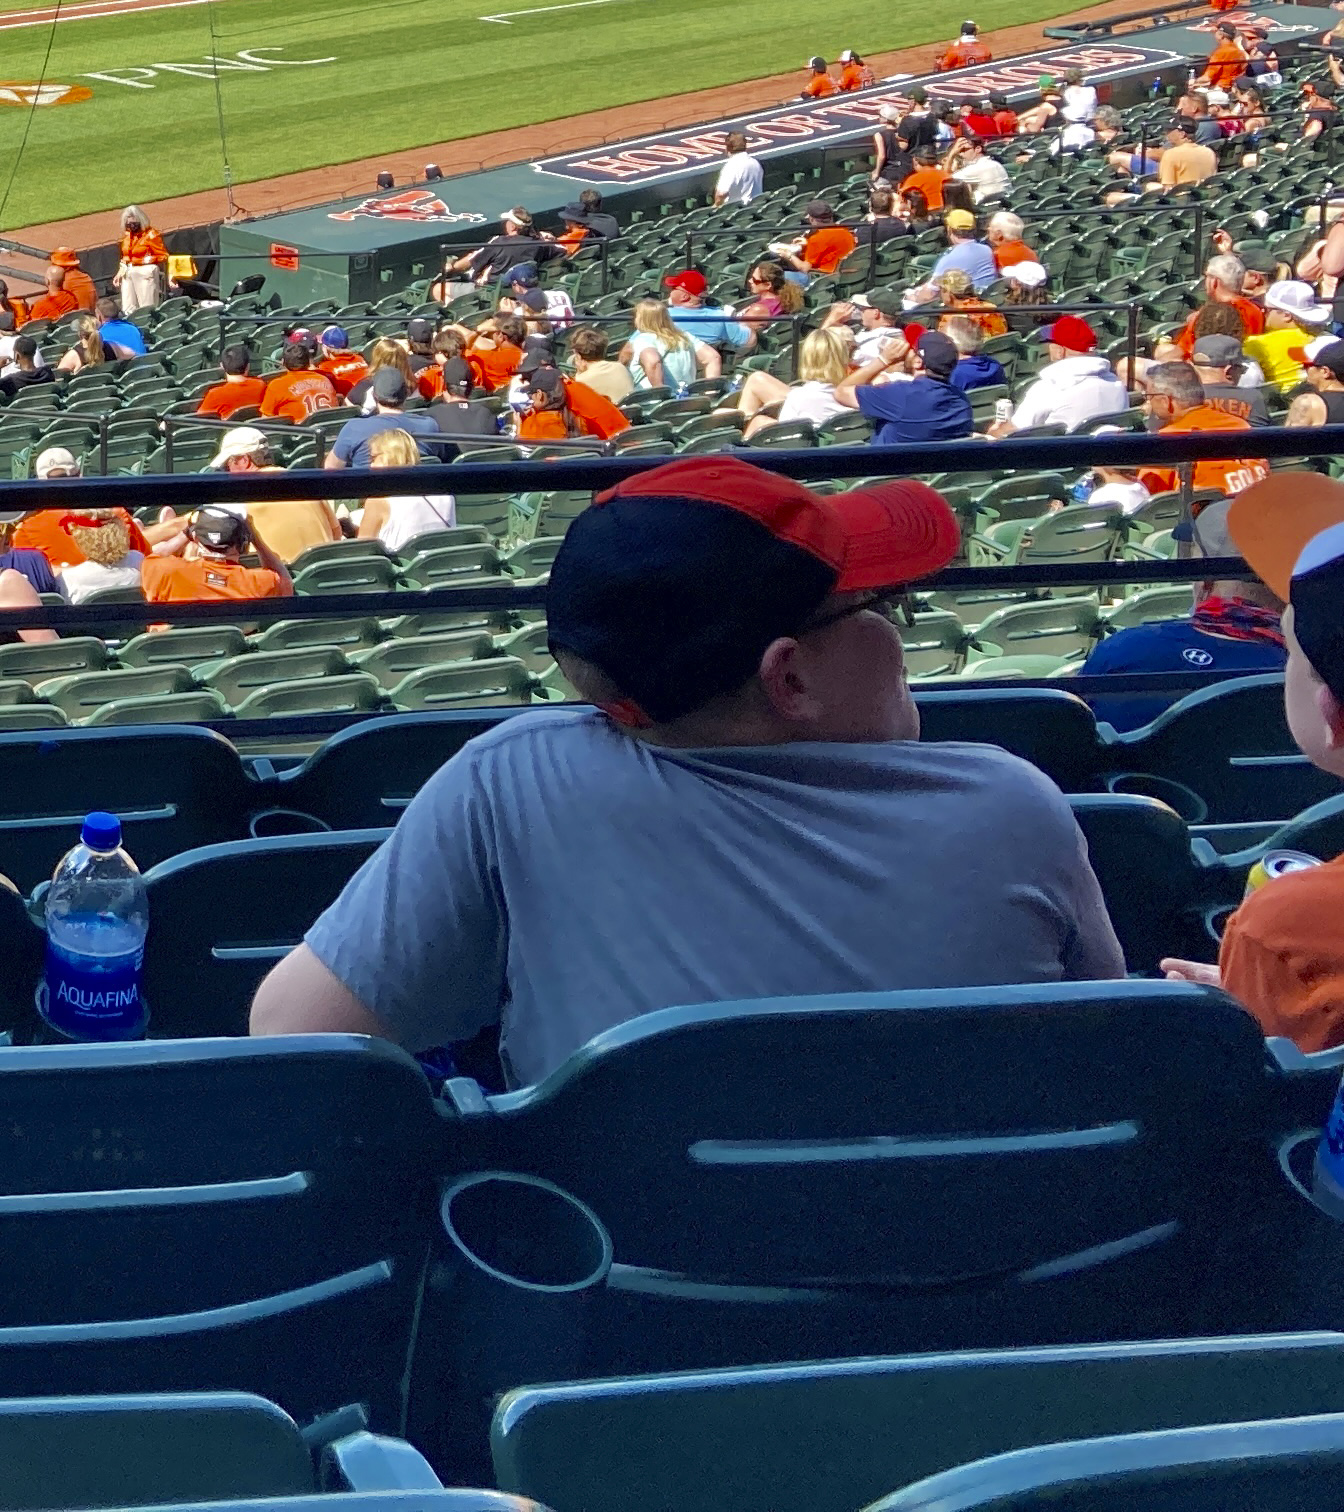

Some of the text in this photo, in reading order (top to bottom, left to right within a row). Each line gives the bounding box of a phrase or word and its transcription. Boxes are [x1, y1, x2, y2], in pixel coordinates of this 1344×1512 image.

[75, 46, 339, 89] PNC
[746, 114, 842, 137] OF
[302, 393, 331, 416] 16
[57, 980, 139, 1011] AQUAFINA
